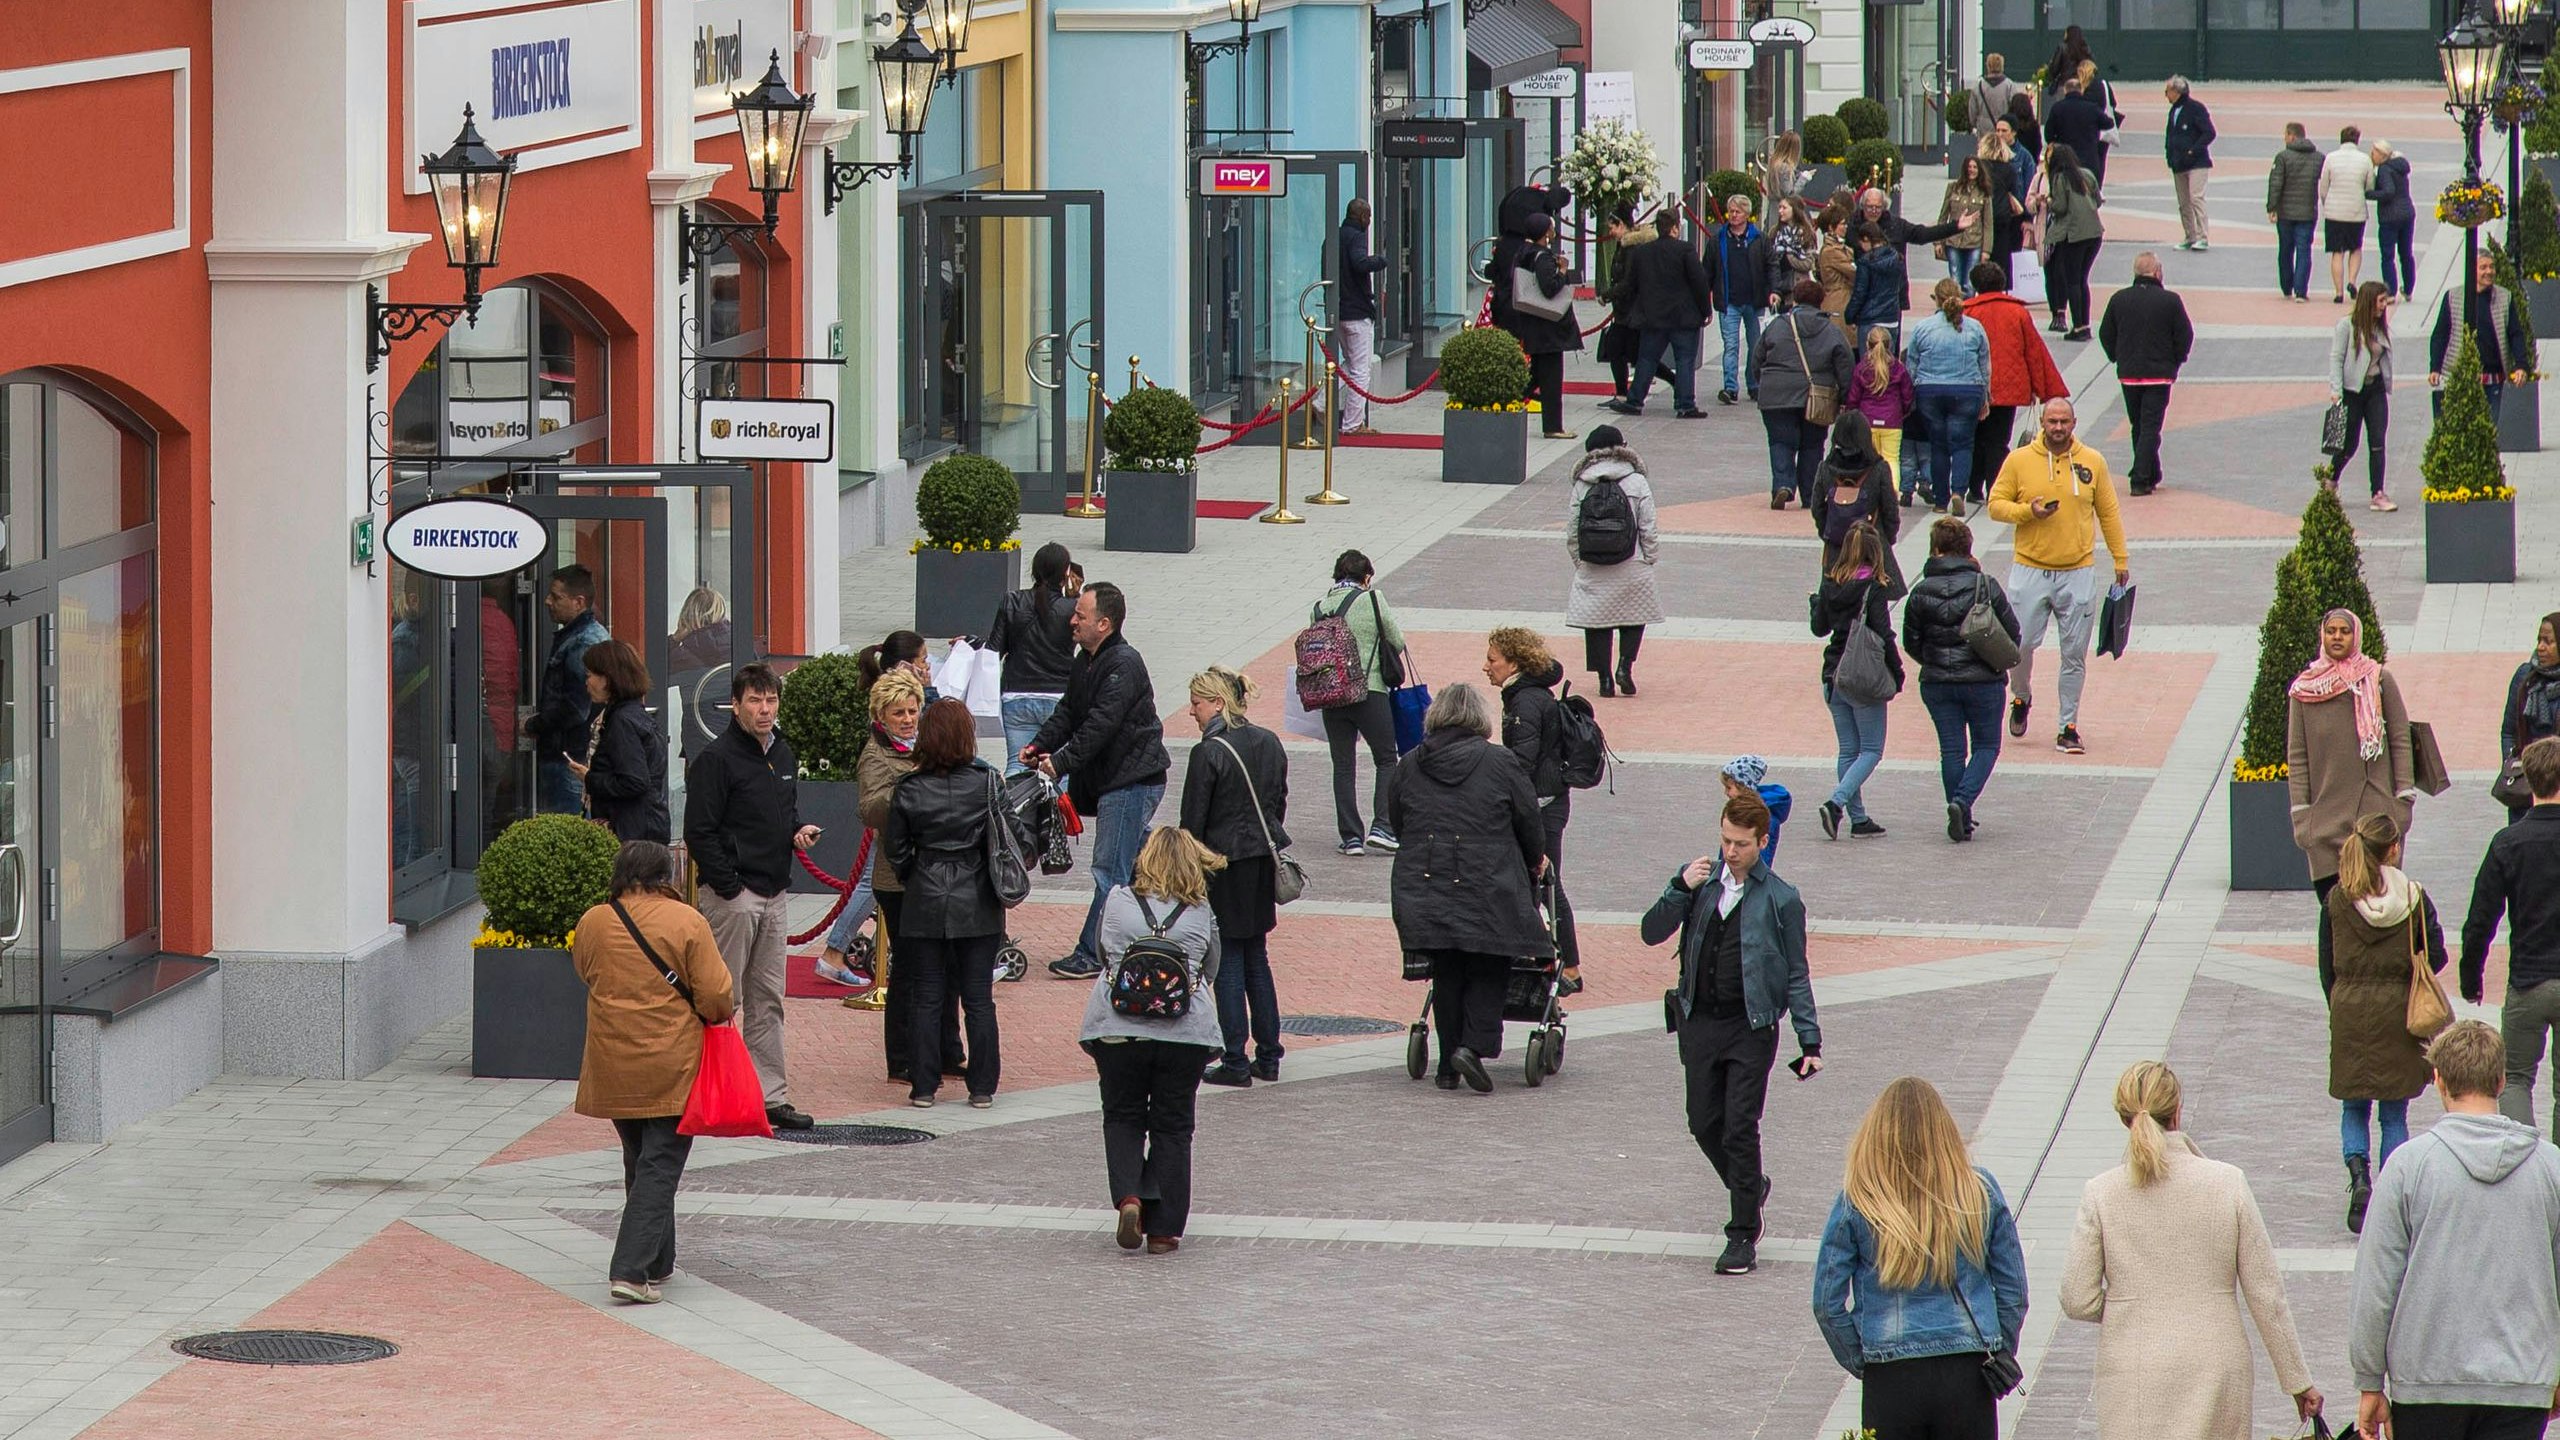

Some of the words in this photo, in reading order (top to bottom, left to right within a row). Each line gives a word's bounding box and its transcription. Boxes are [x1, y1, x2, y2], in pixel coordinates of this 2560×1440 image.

[694, 19, 742, 95] ch&royal
[1697, 47, 1747, 55] ORDINARY
[1704, 54, 1739, 62] HOUSE
[491, 37, 571, 120] BIRKENSTOCK
[1524, 74, 1570, 82] DINARY
[1523, 82, 1561, 90] HOUSE
[1427, 135, 1455, 143] LUGGAGE
[1220, 169, 1265, 187] mey
[736, 421, 820, 442] rich&royal
[413, 528, 518, 549] BIRKENSTOCK
